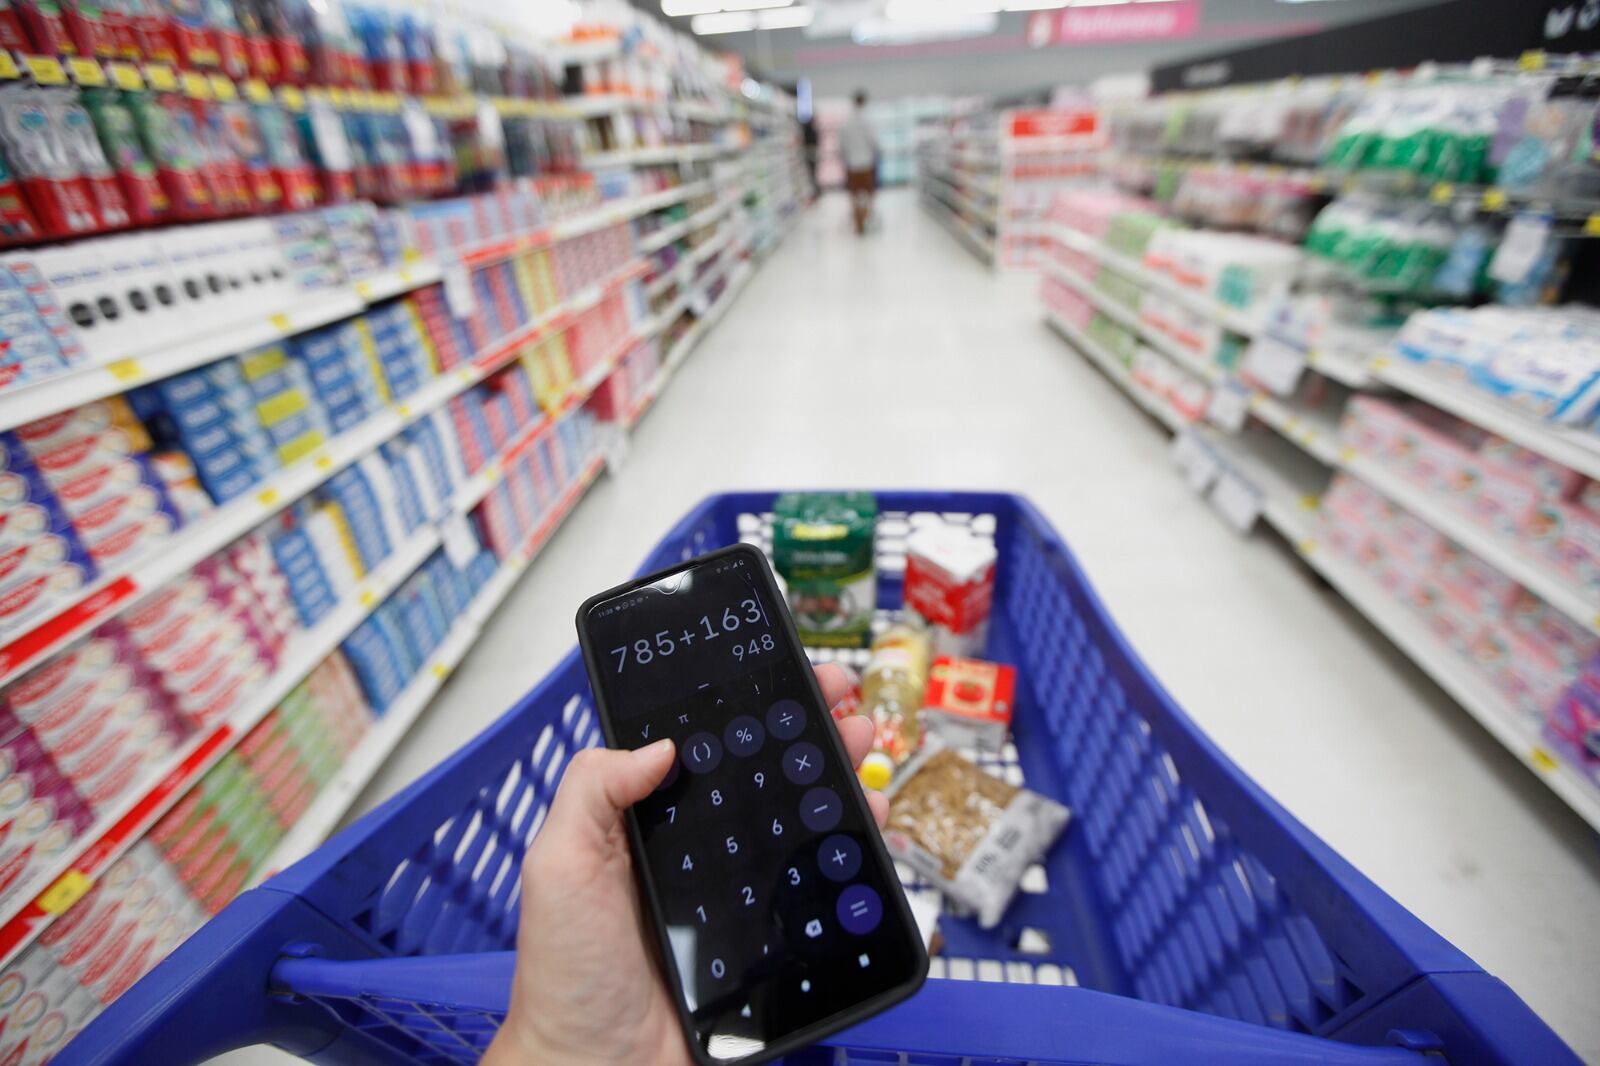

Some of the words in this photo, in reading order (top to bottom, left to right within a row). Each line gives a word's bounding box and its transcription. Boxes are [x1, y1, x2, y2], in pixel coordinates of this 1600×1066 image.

[610, 599, 762, 674] 785+163
[731, 633, 775, 662] 948
[736, 727, 753, 744] %
[666, 806, 677, 824] 7
[711, 789, 724, 805] 8
[753, 772, 765, 789] 9
[682, 854, 694, 871] 4
[726, 836, 739, 854] 5
[772, 818, 784, 836] 6
[696, 905, 708, 923] 1
[741, 886, 756, 905] 2
[788, 867, 801, 886] 3
[711, 958, 726, 979] 0
